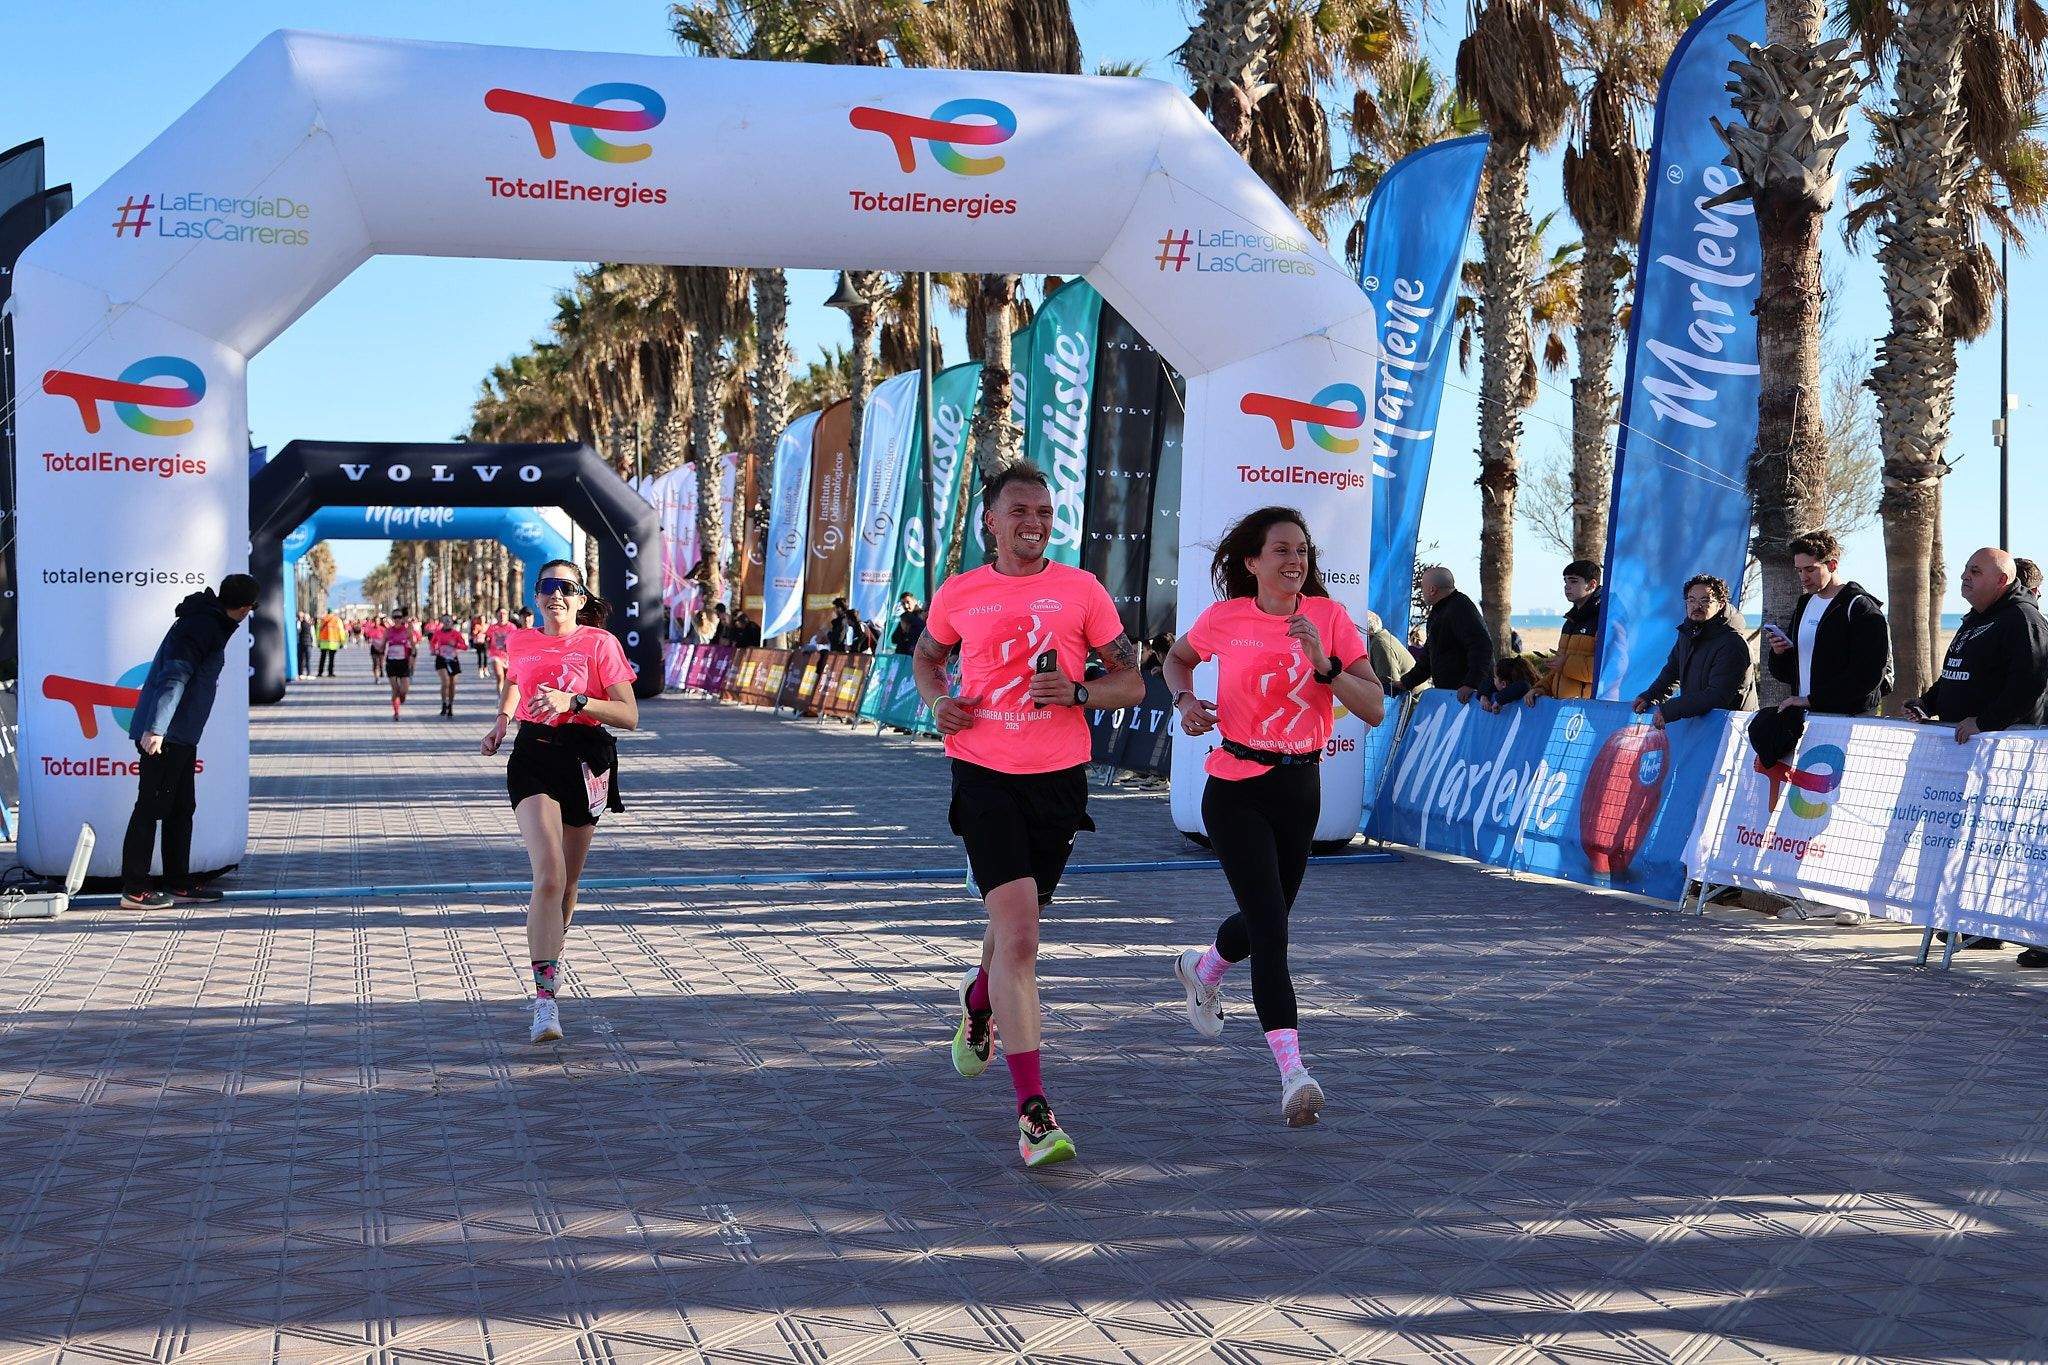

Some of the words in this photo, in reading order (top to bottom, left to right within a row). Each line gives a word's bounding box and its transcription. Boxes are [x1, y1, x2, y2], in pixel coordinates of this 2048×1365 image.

[485, 176, 667, 208] TotalEnergies
[849, 191, 1017, 219] TotalEnergies
[159, 217, 309, 246] LasCarreras
[1196, 252, 1316, 277] LasCarreras
[1642, 165, 1761, 429] Marlene
[1107, 342, 1155, 352] VOLV
[1373, 277, 1434, 479] Marlene
[1102, 405, 1151, 416] VOLV
[1043, 331, 1091, 551] Batiste
[42, 452, 207, 479] TotalEnergies
[339, 464, 542, 483] VOLVO
[1236, 465, 1364, 490] TotalEnergies
[819, 474, 831, 522] Institutos
[364, 506, 455, 535] Marlene
[42, 567, 206, 587] totalenergies.es
[968, 603, 1002, 616] OYSHO
[1230, 639, 1264, 648] OYSHO
[1947, 657, 1963, 667] NEW
[1941, 670, 1970, 681] EALAND
[974, 708, 1002, 721] CARRERA
[1005, 711, 1015, 721] DE
[1016, 712, 1026, 721] LA
[1027, 710, 1052, 722] MUJER
[1005, 721, 1020, 730] 2025
[41, 756, 205, 777] TotalEnes
[1392, 702, 1568, 854] Marlene
[1922, 786, 1963, 803] Somos
[1990, 820, 2015, 834] que
[1736, 825, 1826, 861] TotalEnergies
[1924, 834, 1976, 852] carreras
[1980, 841, 2048, 861] preferidas
